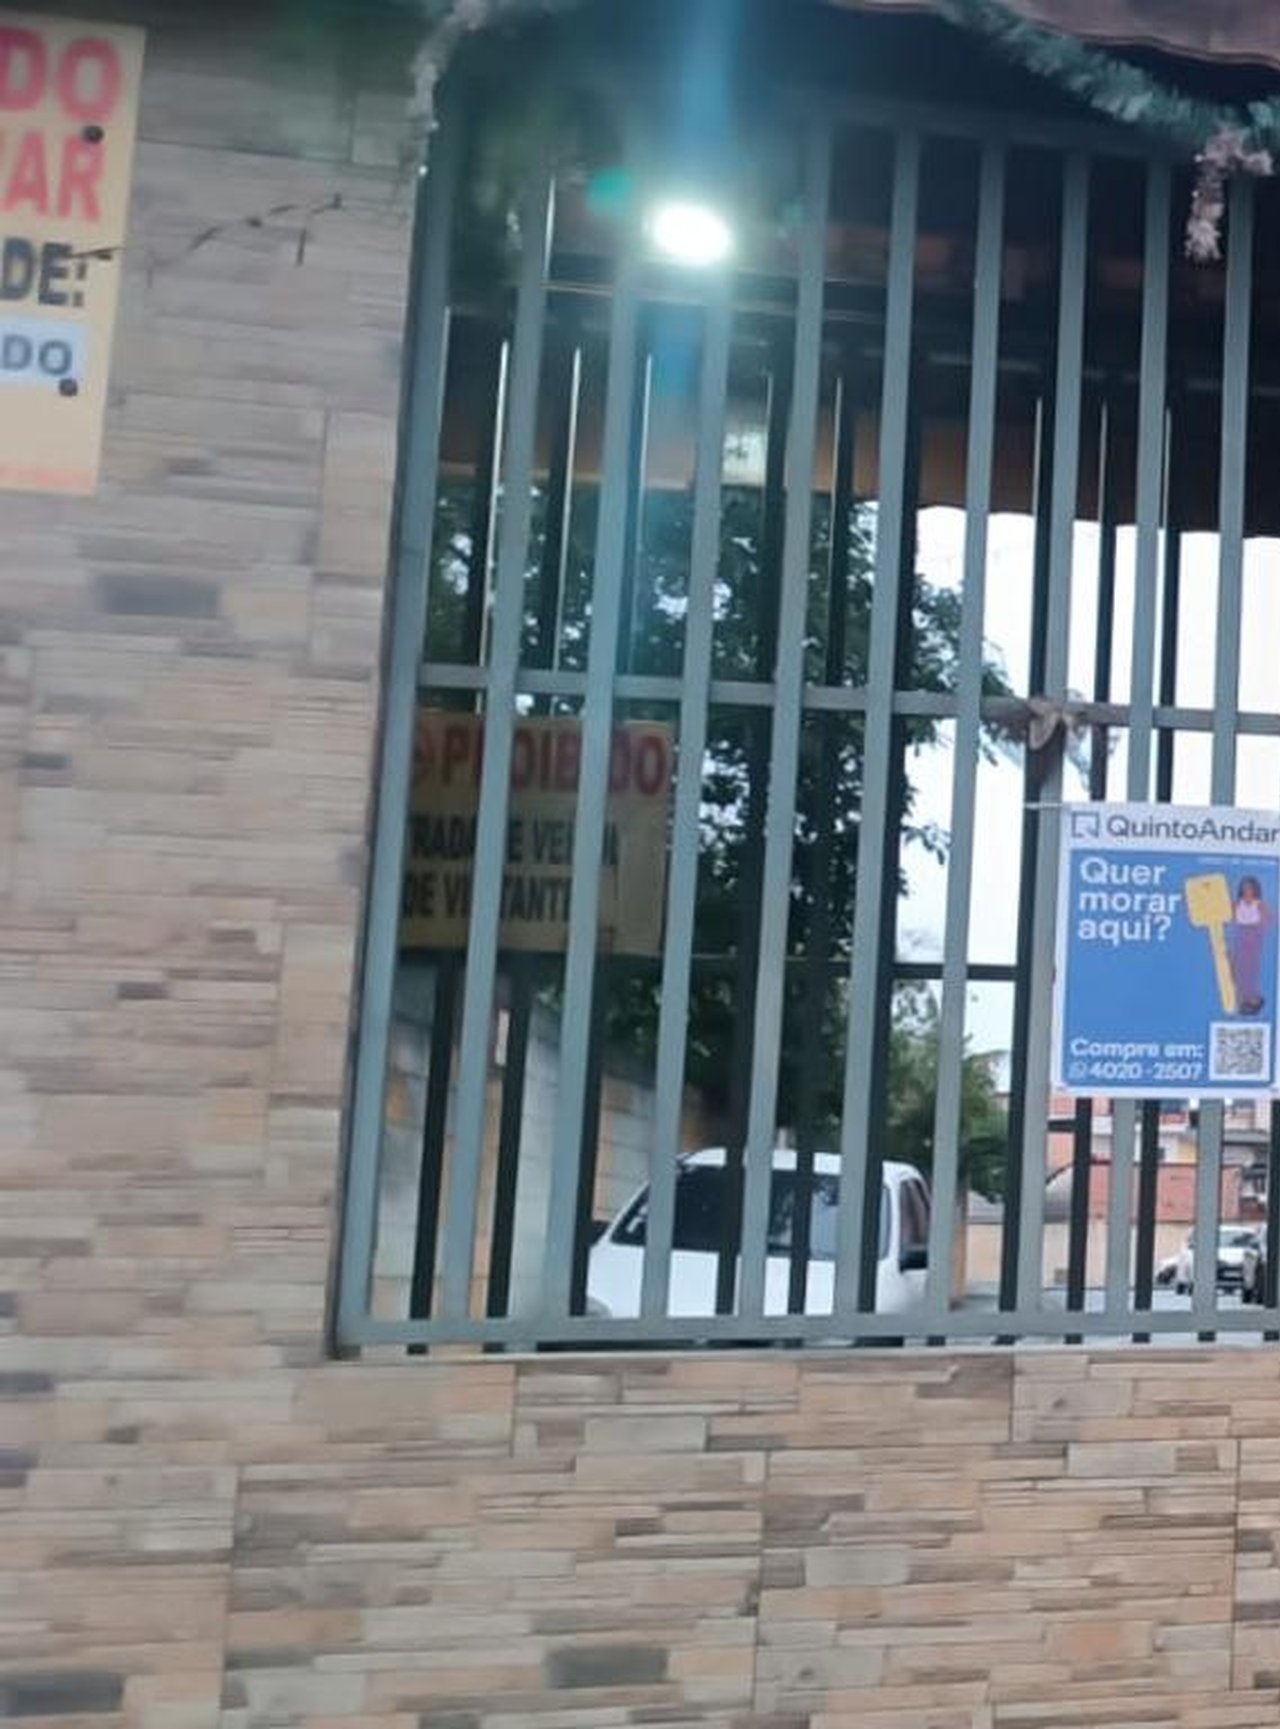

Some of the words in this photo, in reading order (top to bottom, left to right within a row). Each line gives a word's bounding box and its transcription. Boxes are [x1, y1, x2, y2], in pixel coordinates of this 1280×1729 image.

[0, 129, 104, 221] AR
[1106, 814, 1280, 843] QuintoAndar
[1079, 857, 1167, 885] Quer
[1079, 890, 1182, 914] morar
[1077, 914, 1172, 946] aqui?
